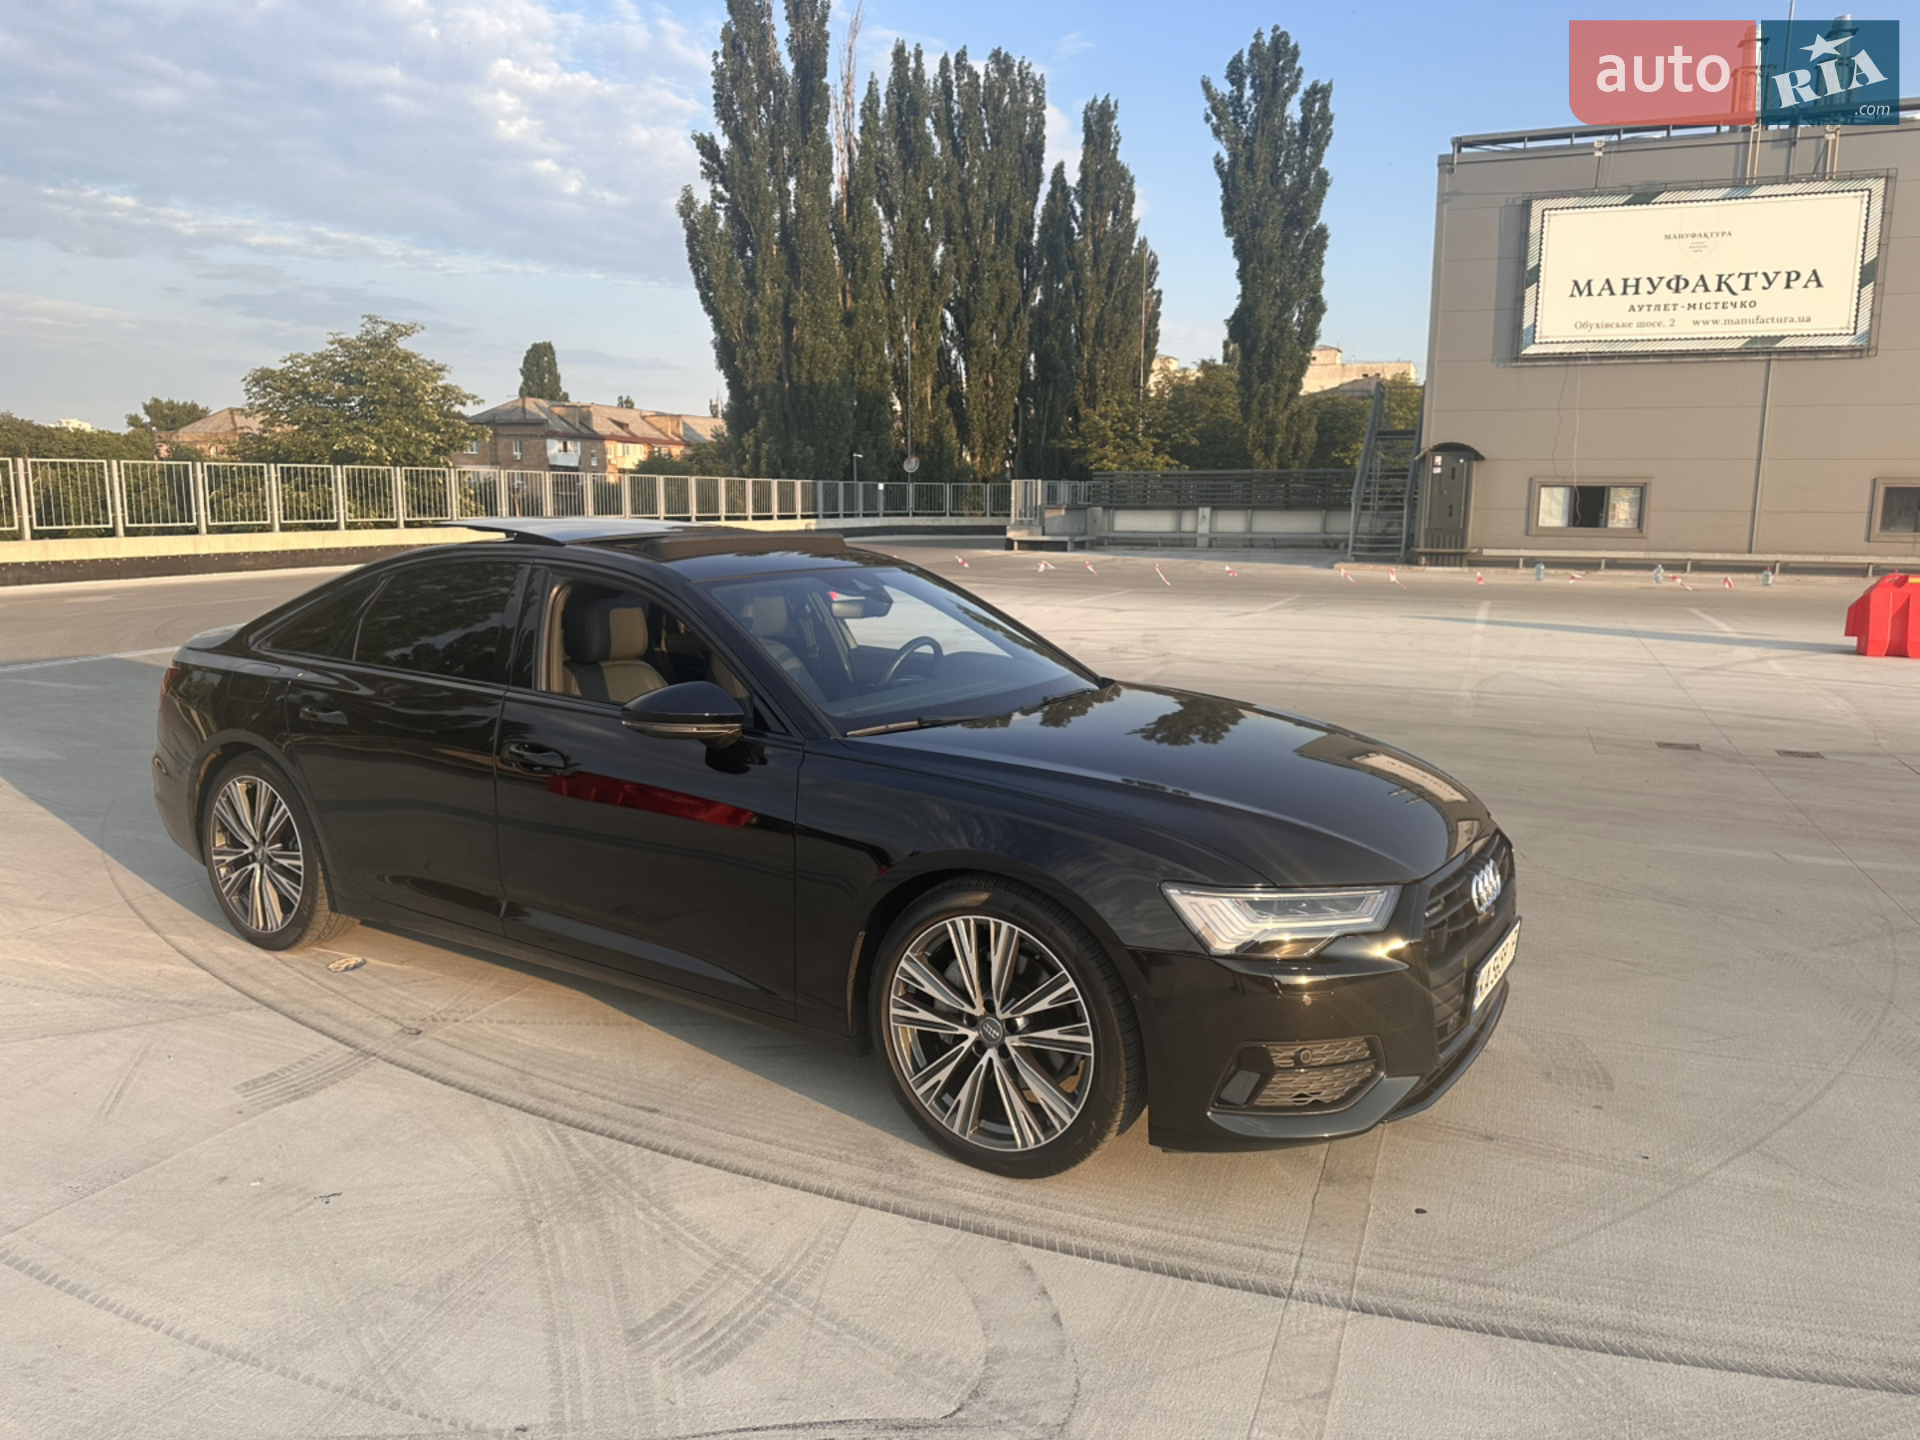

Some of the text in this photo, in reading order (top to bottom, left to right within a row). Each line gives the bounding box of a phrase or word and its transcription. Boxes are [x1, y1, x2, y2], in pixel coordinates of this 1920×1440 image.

[1663, 230, 1733, 240] МАНУФАКТУРА
[1568, 268, 1824, 298] МАНУФАКТУРА
[1627, 300, 1757, 313] АУТЛЕТ-МІСТЕЧКО
[1574, 320, 1634, 332] Обухівське
[1668, 318, 1676, 327] 2
[1692, 314, 1812, 326] www.manufactura.ua
